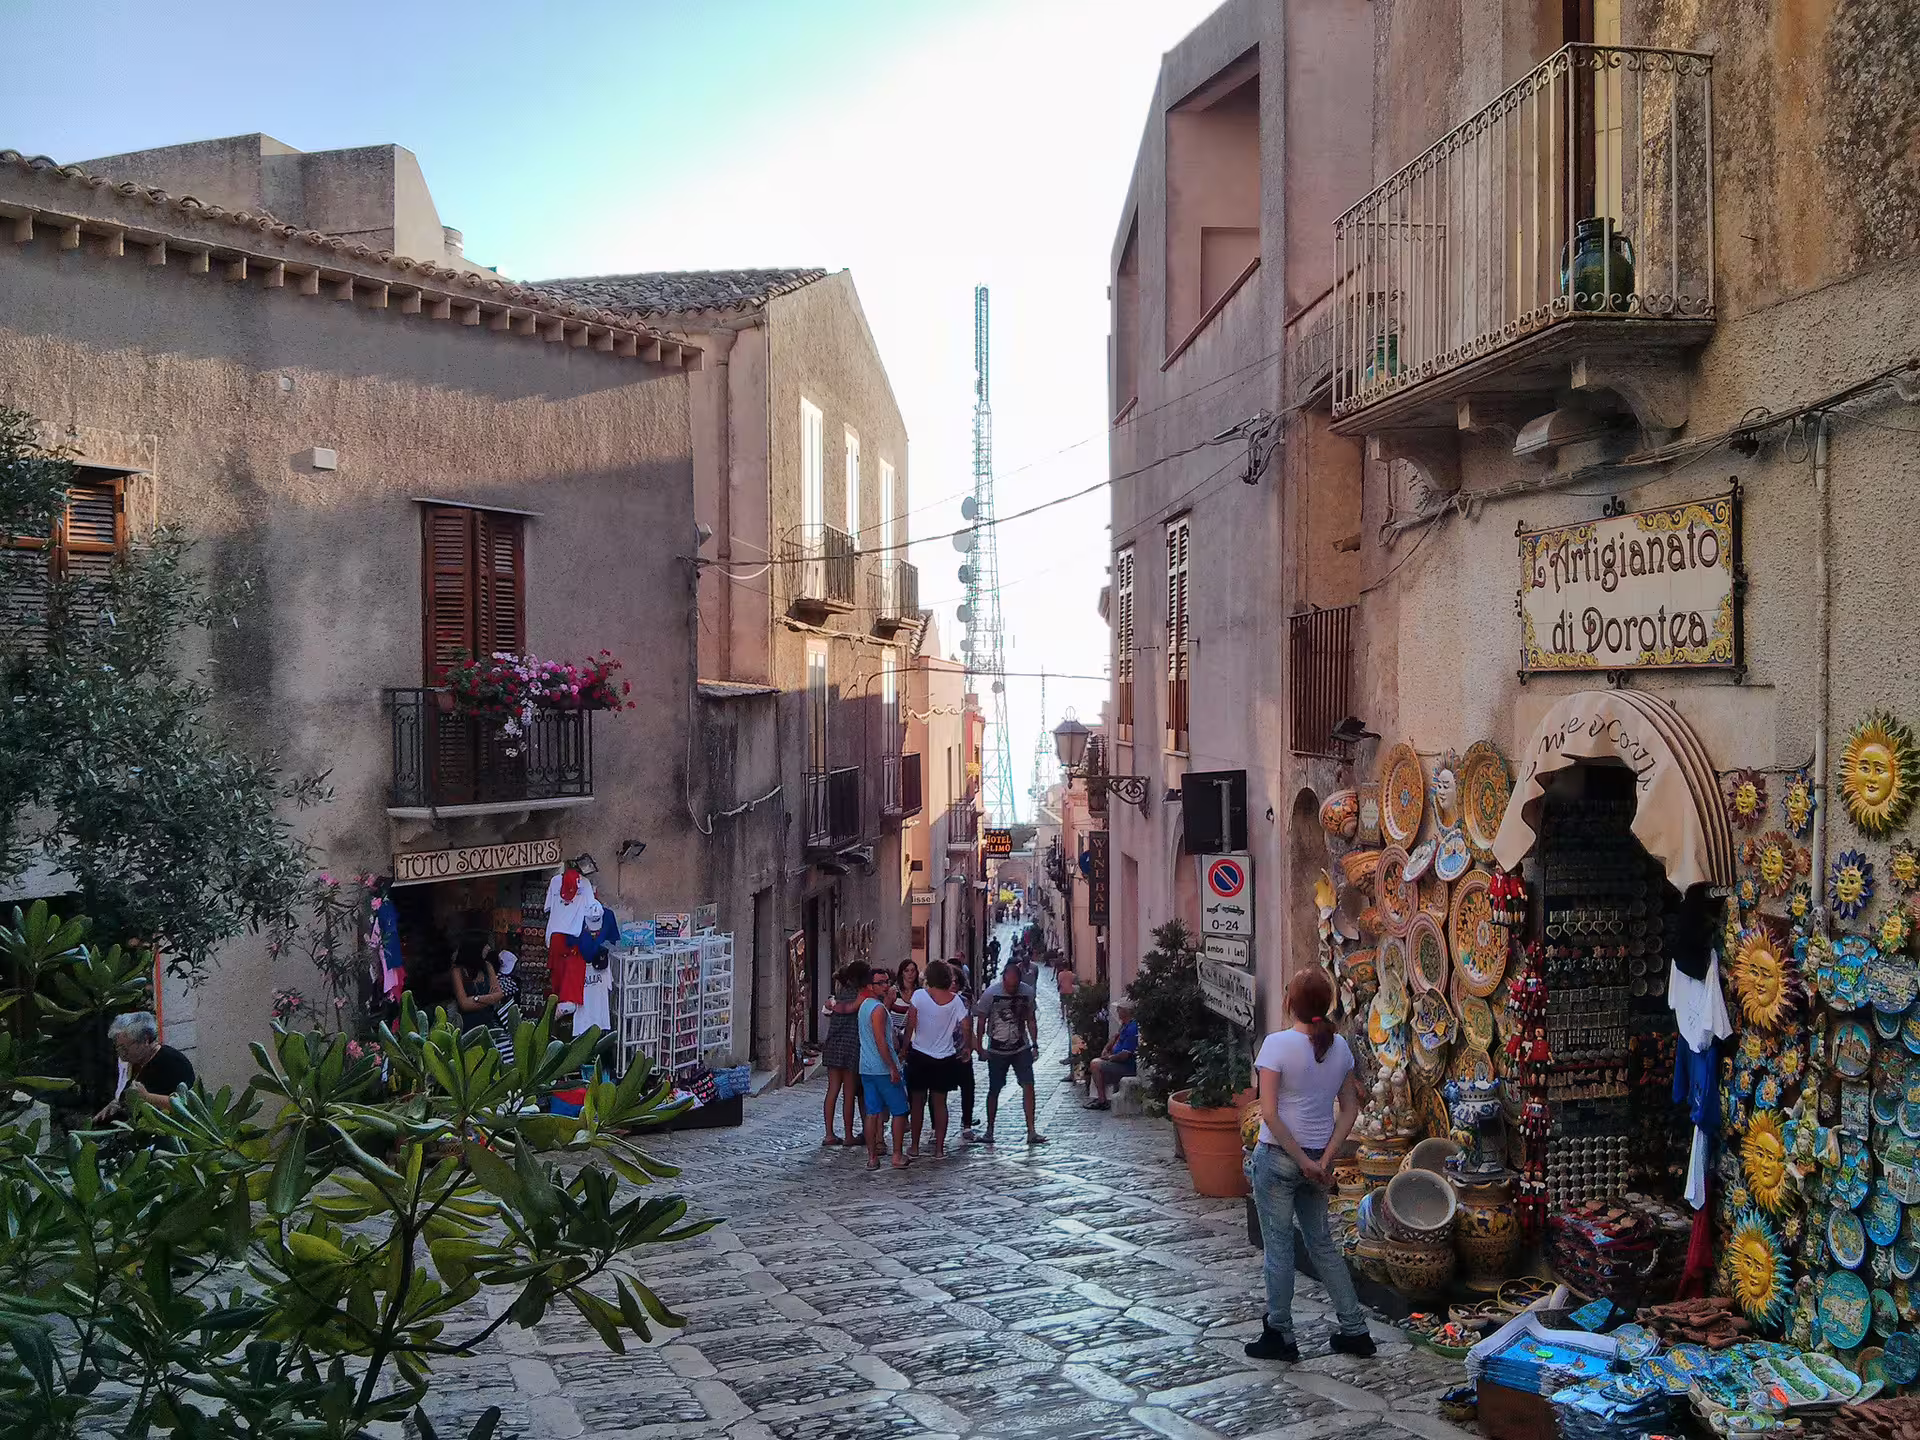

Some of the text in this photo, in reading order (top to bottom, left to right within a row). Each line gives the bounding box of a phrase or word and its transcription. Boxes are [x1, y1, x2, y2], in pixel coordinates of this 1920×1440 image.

[1531, 521, 1720, 593] L'Artigianato
[1552, 605, 1708, 656] di Dorotea
[985, 834, 1012, 844] HOTEL
[986, 844, 1011, 852] ELIMO
[456, 841, 558, 873] SOUVENIR'S
[1093, 838, 1106, 912] WINE BAR
[1211, 920, 1240, 932] 0-24
[1207, 944, 1224, 954] ambo
[1234, 947, 1245, 958] lati
